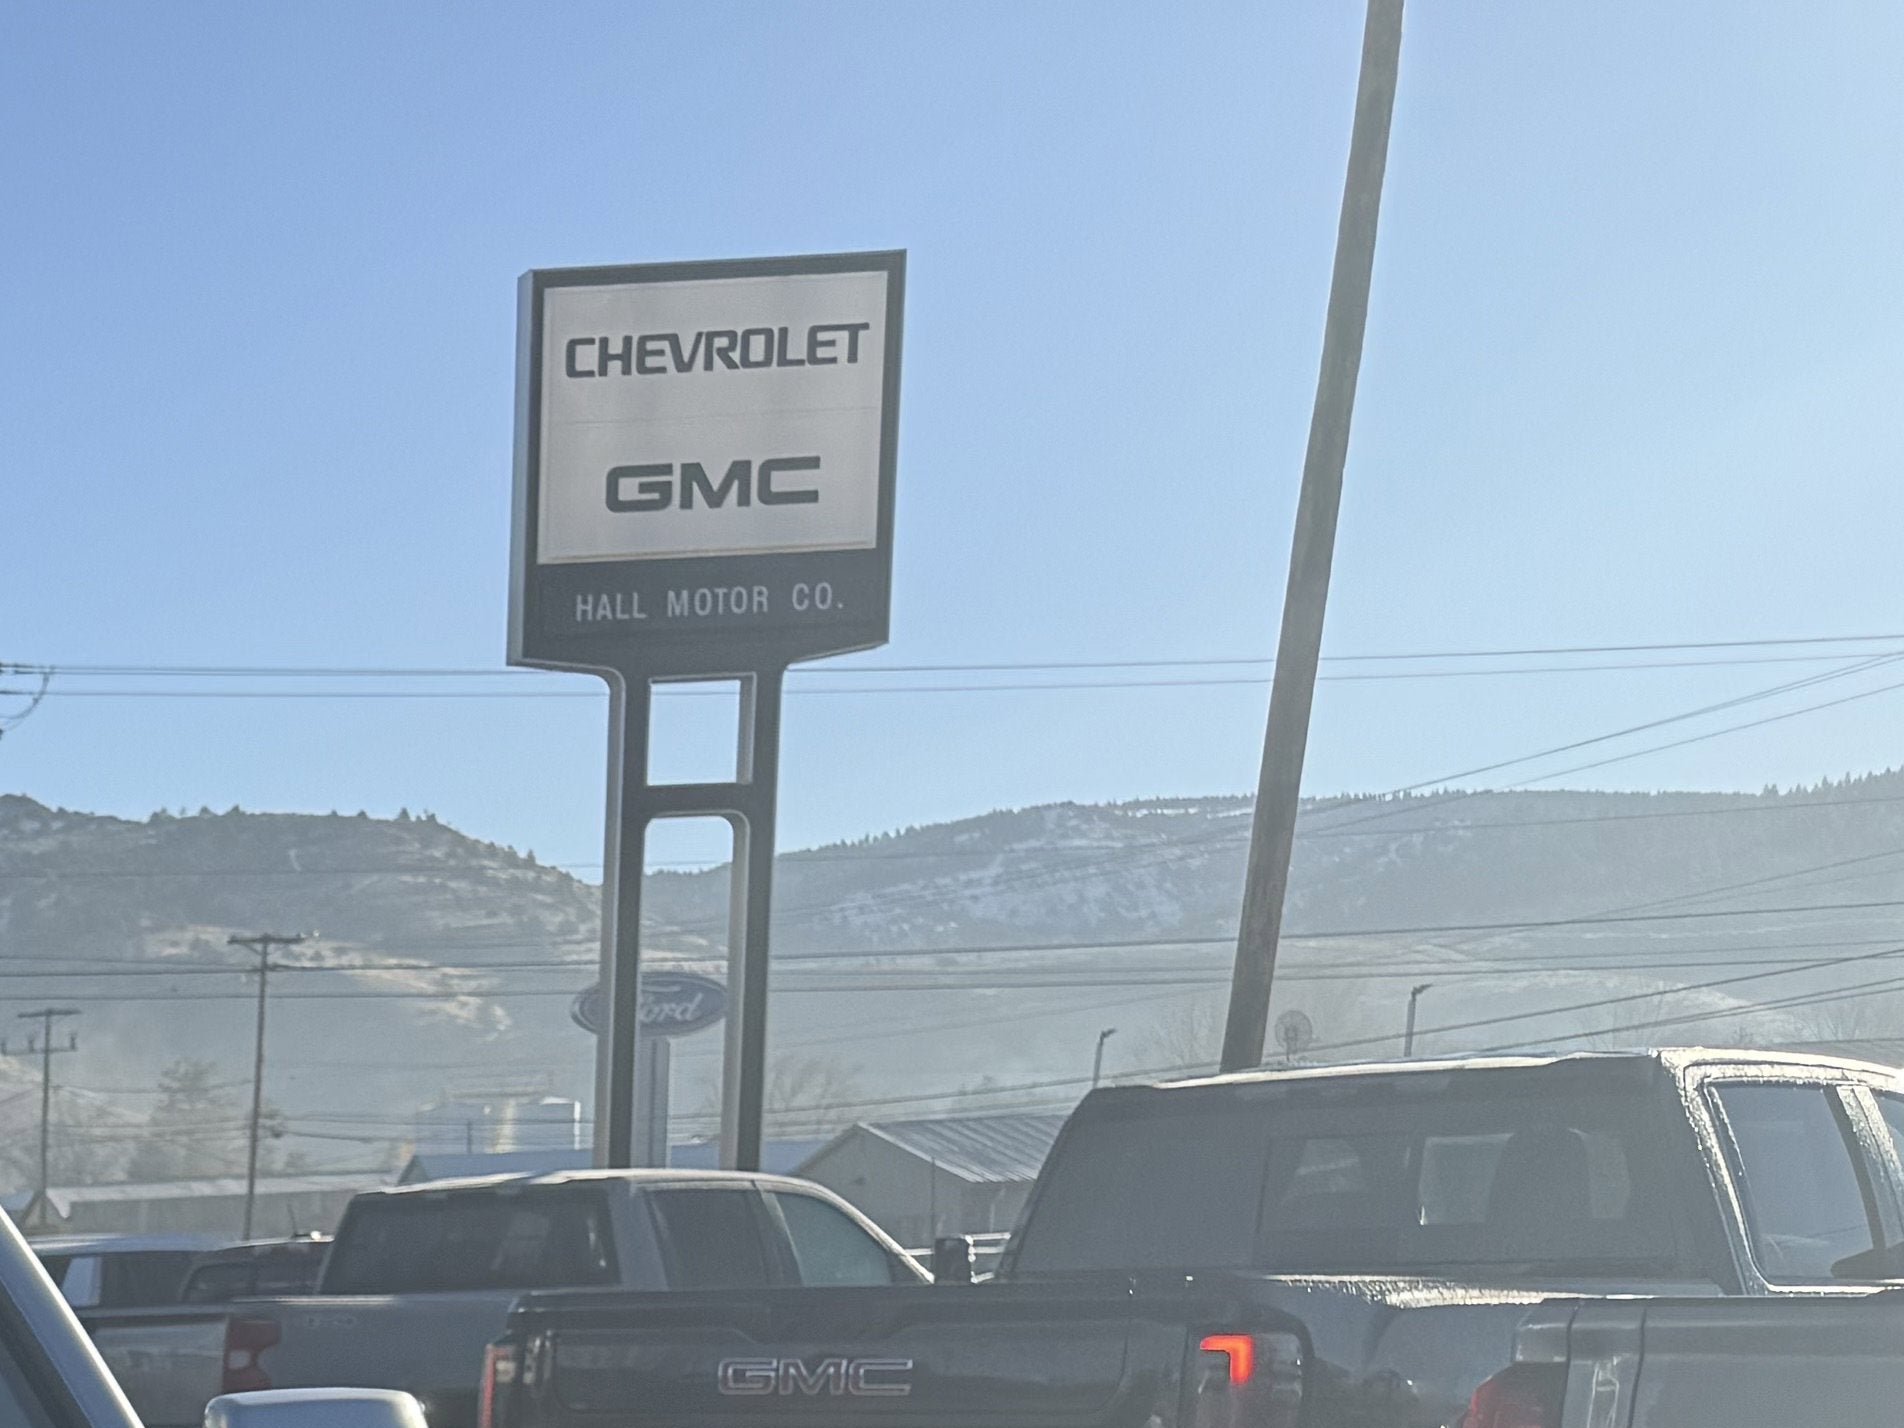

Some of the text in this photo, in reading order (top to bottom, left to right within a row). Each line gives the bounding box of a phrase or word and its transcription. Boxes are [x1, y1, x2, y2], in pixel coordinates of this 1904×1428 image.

[565, 322, 870, 378] CHEVROLET
[605, 455, 821, 513] GMC
[576, 582, 843, 621] HALL MOTOR CO.
[718, 1357, 913, 1396] GMC
